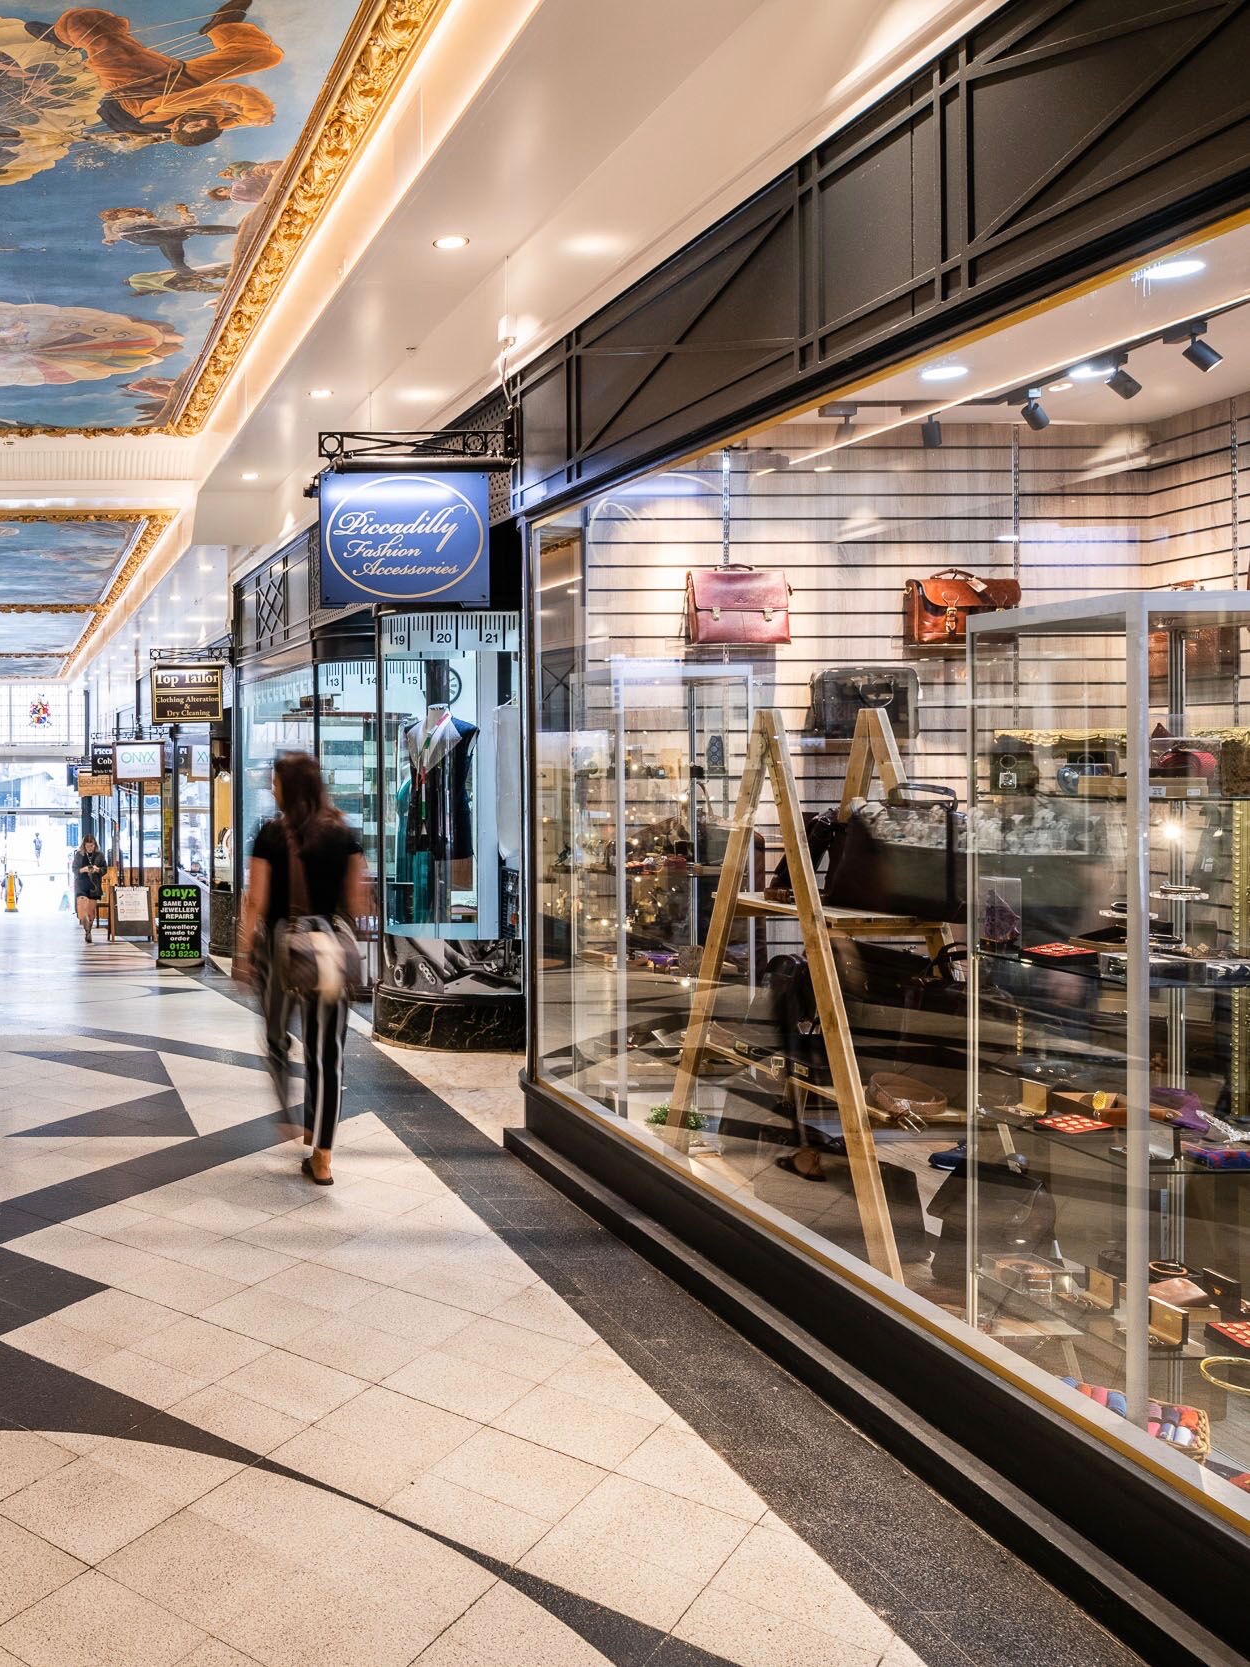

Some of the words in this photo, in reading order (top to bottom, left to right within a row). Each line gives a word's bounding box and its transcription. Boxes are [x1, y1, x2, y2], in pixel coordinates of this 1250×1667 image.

[333, 504, 469, 553] Piccadilly
[343, 535, 421, 558] Fashion
[352, 558, 459, 577] Accessories
[394, 635, 405, 645] 19
[436, 633, 452, 643] 20
[485, 633, 499, 643] 21
[156, 673, 179, 687] Top
[183, 672, 219, 683] Tailor
[156, 696, 185, 704] Clothing
[167, 710, 180, 718] Dry
[121, 751, 155, 764] ONYX
[162, 888, 197, 900] onyx
